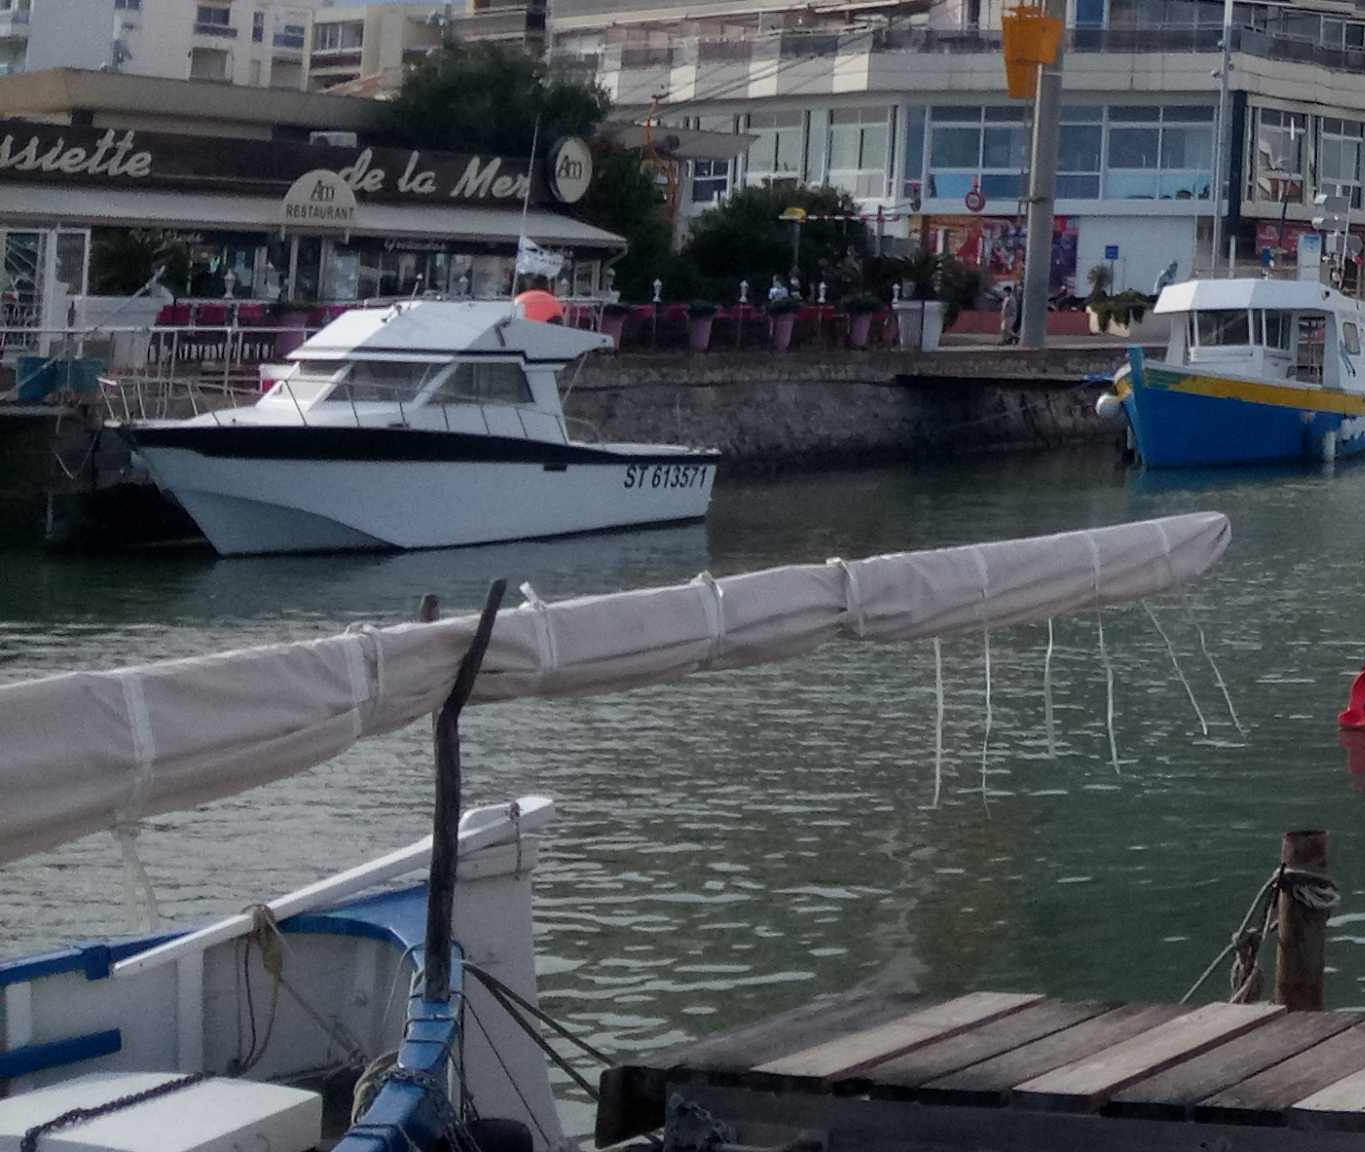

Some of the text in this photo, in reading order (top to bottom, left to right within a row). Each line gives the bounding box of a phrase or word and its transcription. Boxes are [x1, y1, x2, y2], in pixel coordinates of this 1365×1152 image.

[338, 148, 385, 192] de
[398, 150, 437, 195] la
[450, 155, 532, 199] Mer
[286, 204, 354, 219] RESTAURANT
[624, 466, 707, 488] ST 613571
